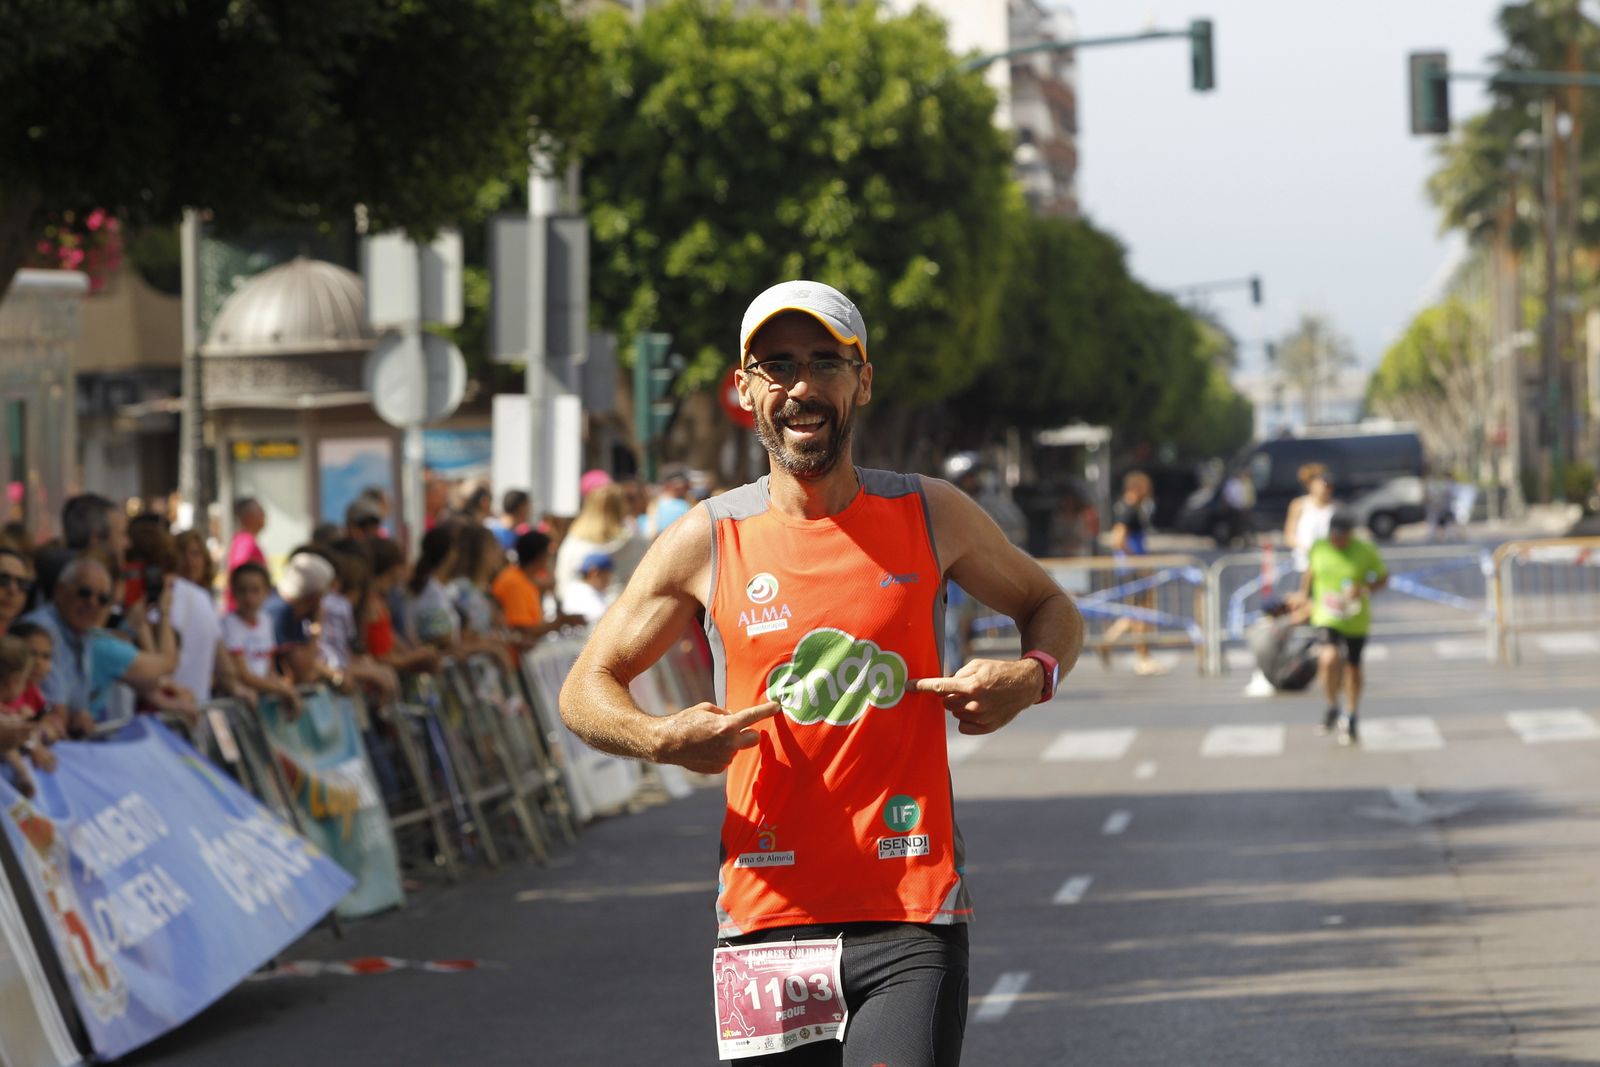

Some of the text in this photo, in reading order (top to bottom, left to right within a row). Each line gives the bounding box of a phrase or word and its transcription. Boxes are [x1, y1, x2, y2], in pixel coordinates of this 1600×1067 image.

[737, 603, 792, 628] ALMA
[892, 804, 916, 825] IF
[879, 836, 928, 851] ISENDI
[879, 848, 929, 859] FARMA
[744, 973, 833, 1010] 1103
[775, 1005, 806, 1022] PEQUE
